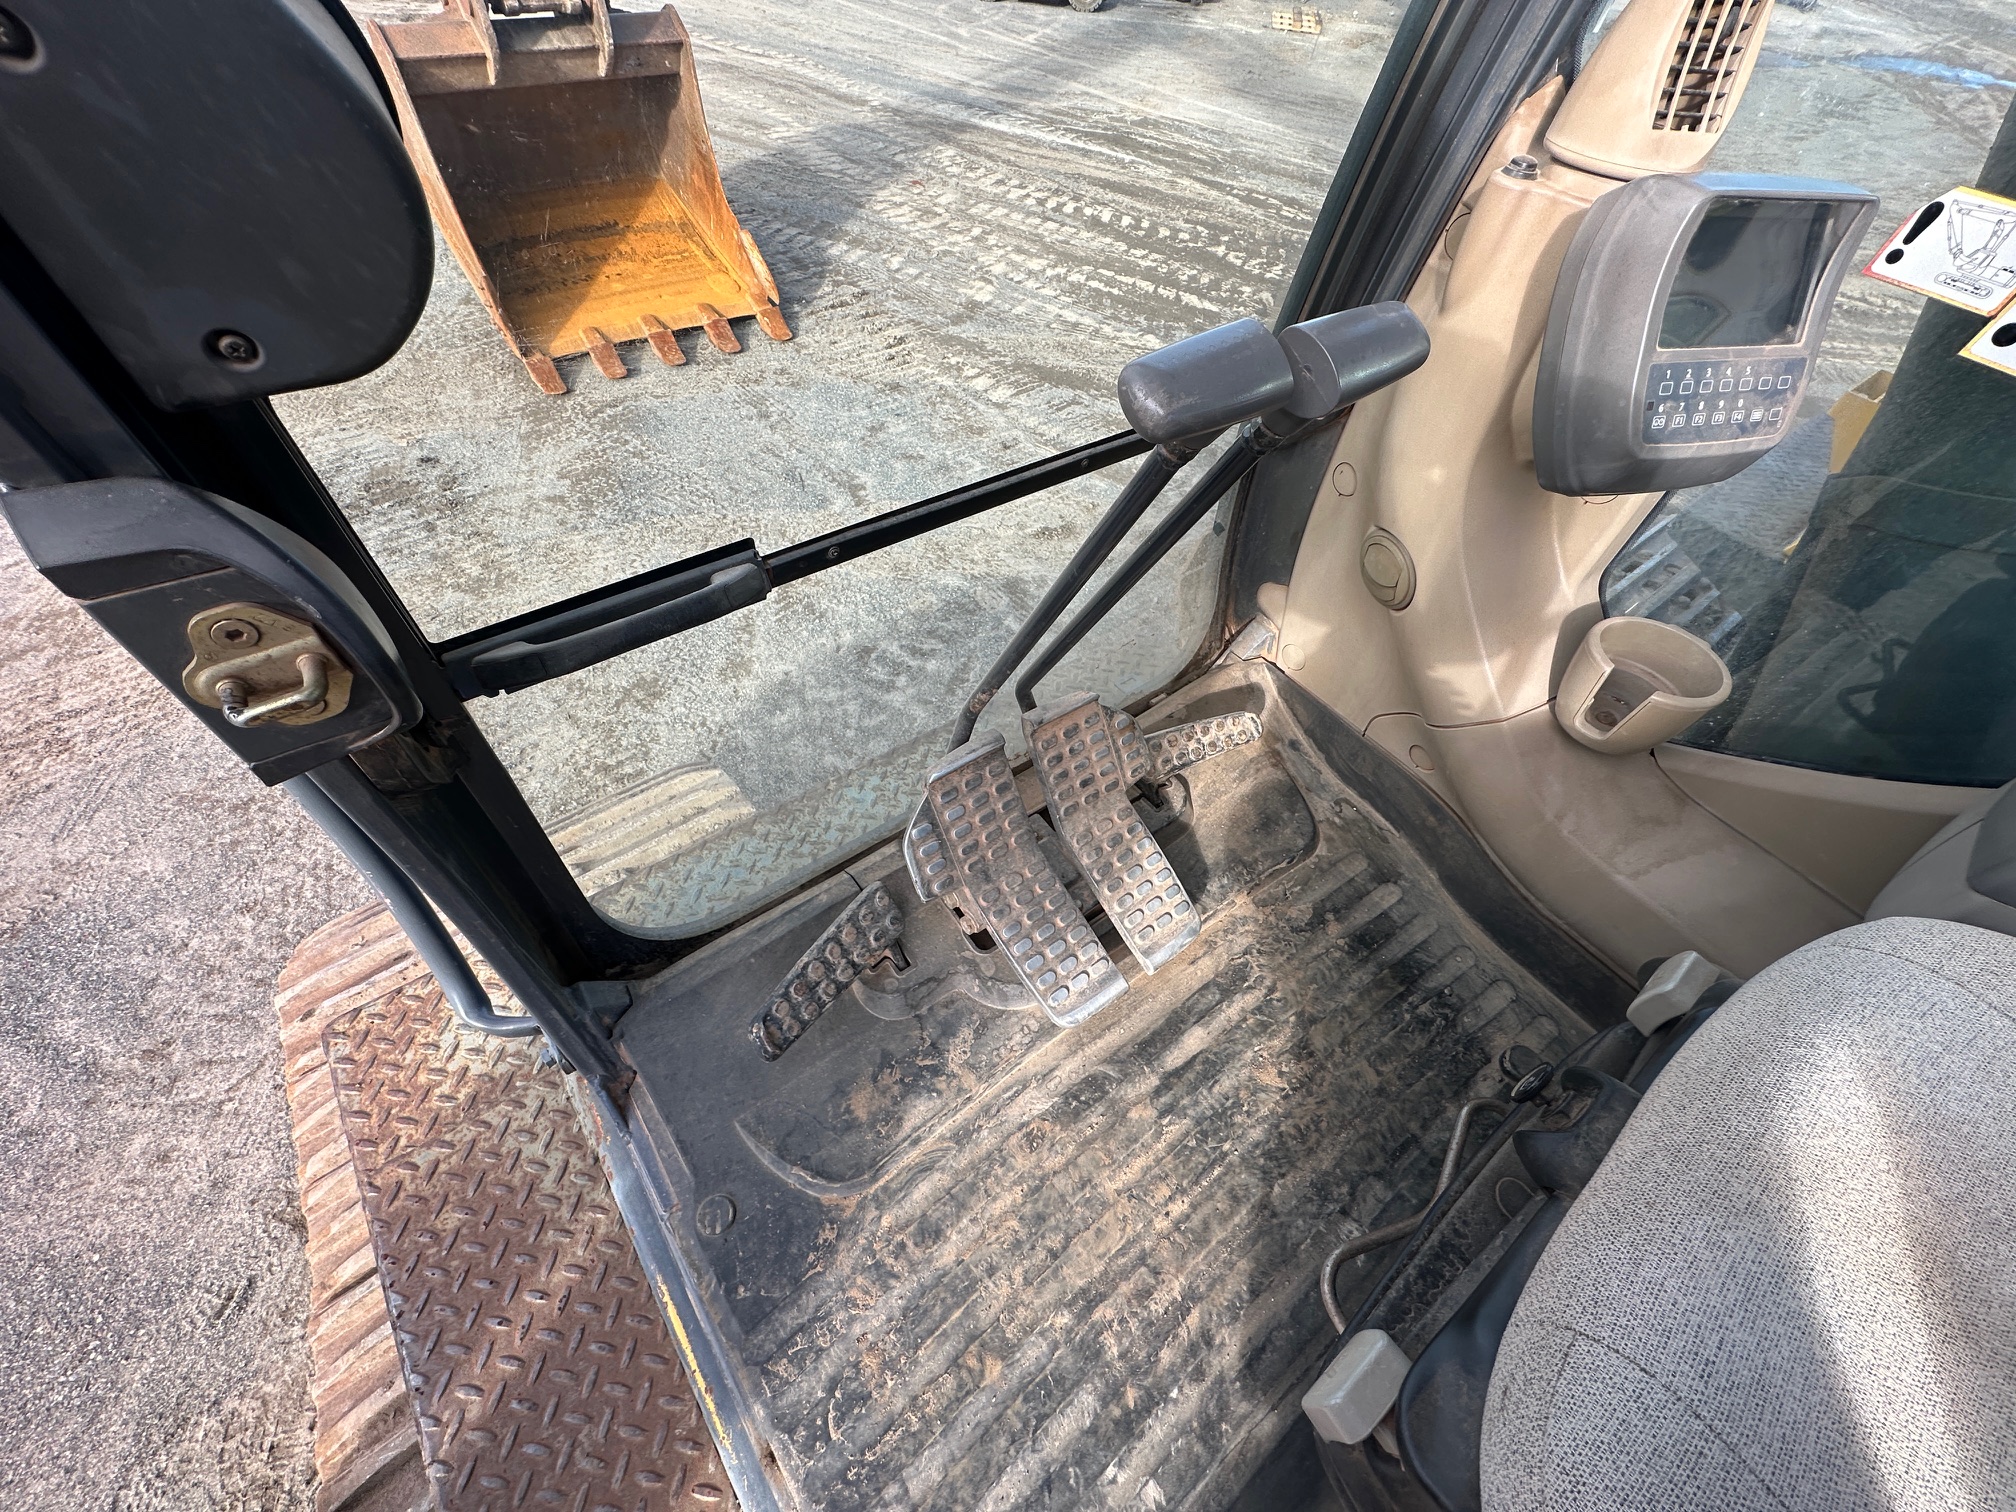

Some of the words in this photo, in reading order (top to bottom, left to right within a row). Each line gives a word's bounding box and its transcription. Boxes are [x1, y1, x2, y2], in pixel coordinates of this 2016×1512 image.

[1666, 369, 1671, 379] 1
[1685, 368, 1692, 378] 2
[1705, 367, 1712, 378] 3
[1725, 366, 1732, 376] 4
[1745, 365, 1751, 376] 5
[1658, 403, 1664, 413] 6
[1678, 402, 1685, 412] 7
[1698, 400, 1704, 411] 8
[1718, 399, 1725, 409] 9
[1674, 416, 1683, 425] F1
[1694, 415, 1703, 424] F2
[1714, 414, 1723, 422] F3
[1733, 412, 1742, 421] F4
